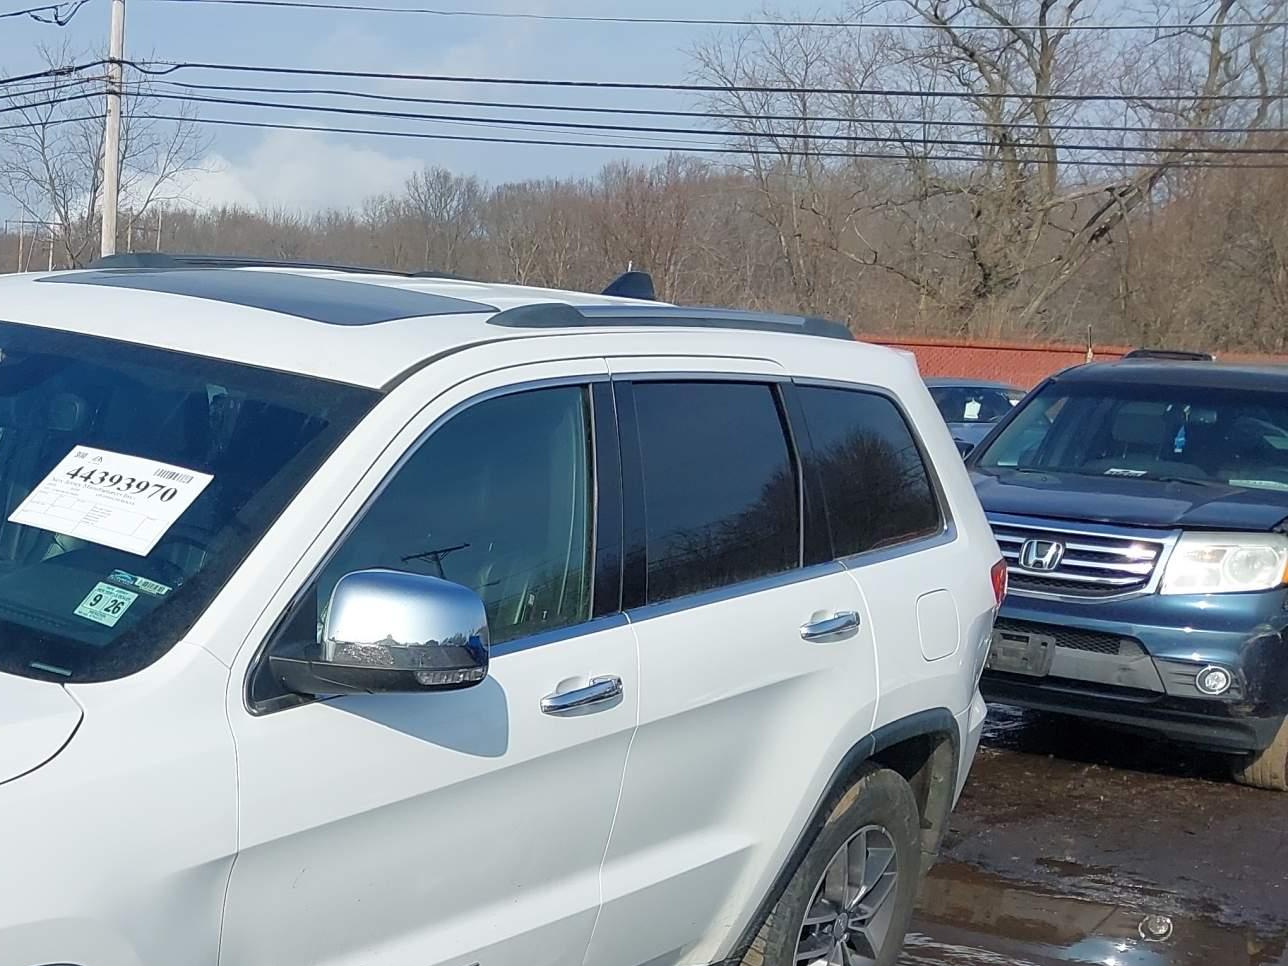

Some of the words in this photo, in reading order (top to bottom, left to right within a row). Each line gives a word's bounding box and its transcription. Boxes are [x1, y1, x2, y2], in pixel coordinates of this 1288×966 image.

[66, 466, 178, 502] 44393970
[89, 594, 103, 607] 9
[104, 599, 124, 614] 26
